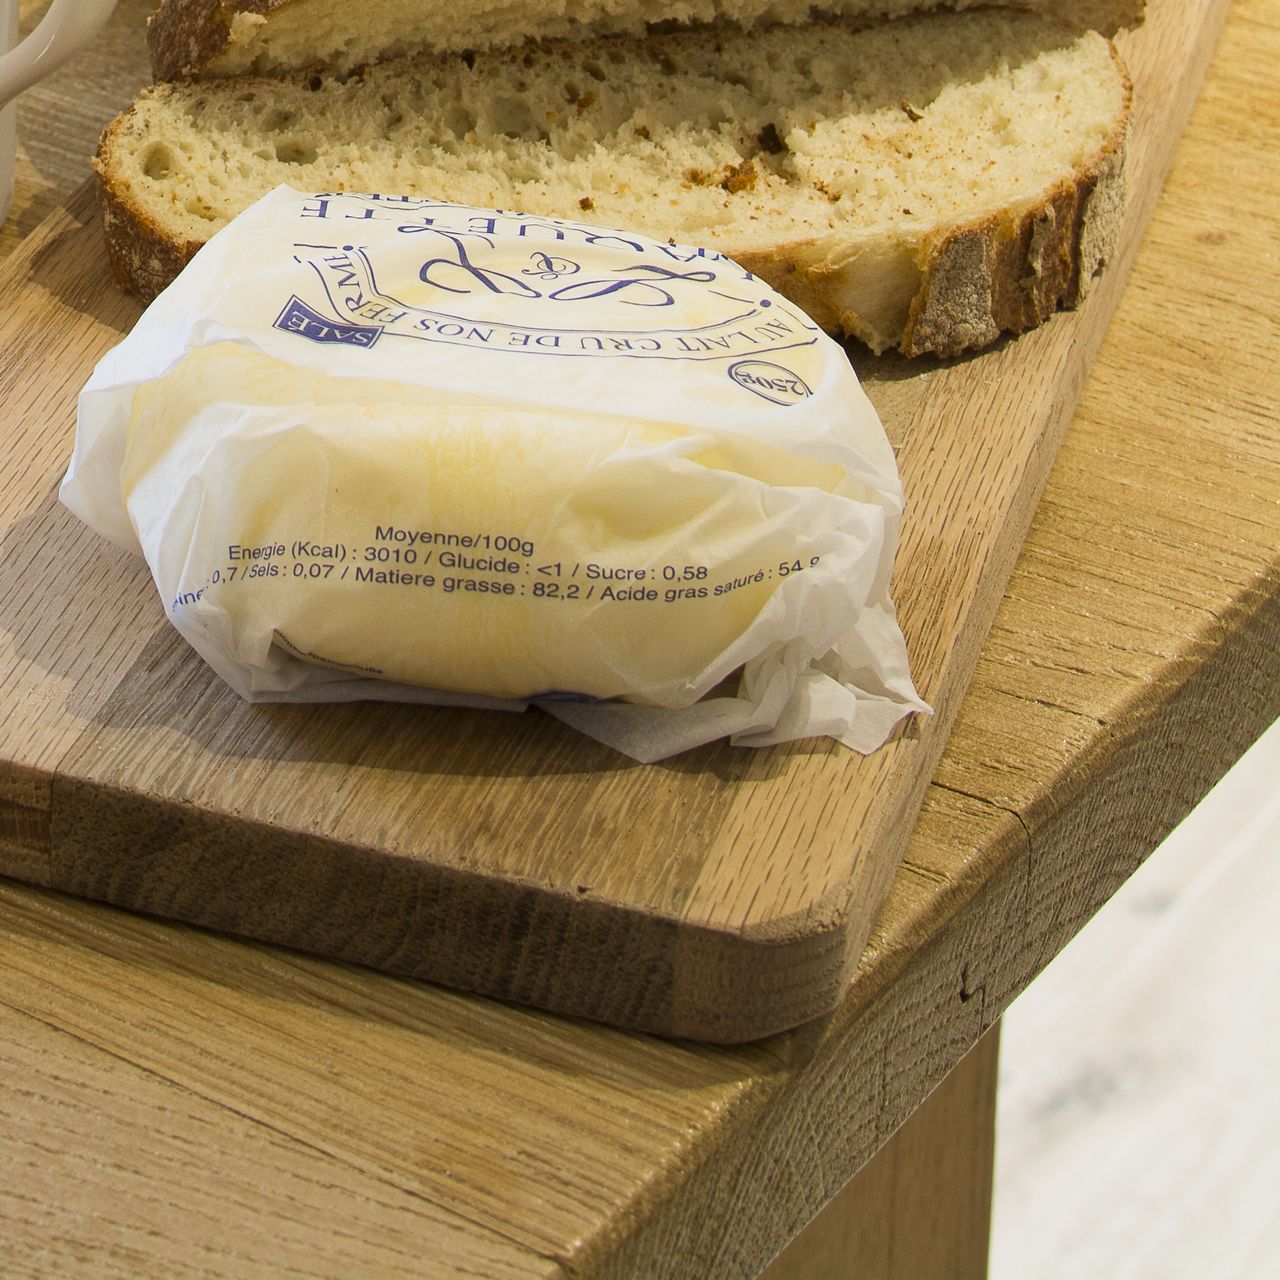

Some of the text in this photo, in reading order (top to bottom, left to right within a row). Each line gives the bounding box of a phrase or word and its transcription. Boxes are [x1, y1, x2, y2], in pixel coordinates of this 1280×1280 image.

[287, 310, 374, 345] SALÉ
[413, 318, 497, 343] NOS
[508, 331, 560, 348] DE
[754, 317, 794, 342] AU
[580, 335, 662, 351] CRU
[676, 330, 760, 352] LAIT
[735, 370, 805, 396] 250g
[375, 525, 535, 557] Moyenne/100g
[228, 541, 286, 562] Energie
[291, 540, 347, 562] (Kcal)
[364, 546, 417, 564] 3010
[438, 551, 520, 574] Glucide
[537, 562, 561, 577] <1
[586, 563, 646, 581] Sucre
[663, 565, 708, 582] 0,58
[293, 562, 335, 579] 0,07
[355, 566, 435, 587] Matiere
[442, 576, 516, 595] grasse
[532, 581, 580, 600] 82,2
[600, 585, 658, 601] Acide
[664, 585, 708, 602] gras
[713, 569, 764, 596] saturé
[778, 559, 804, 577] 54
